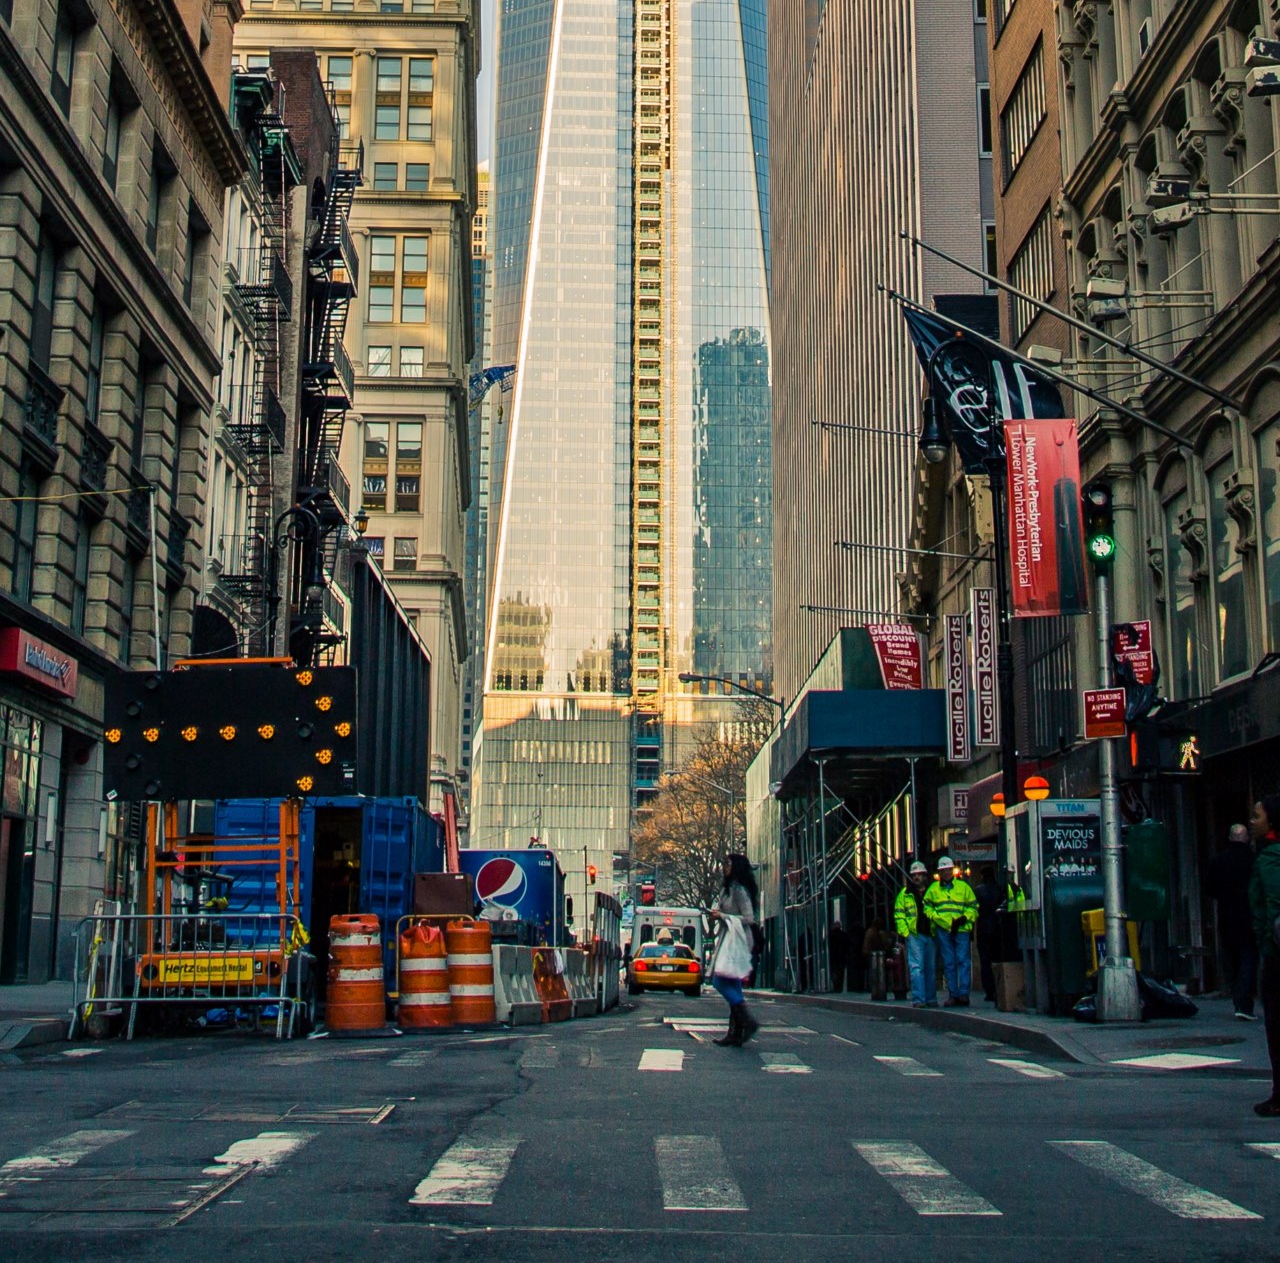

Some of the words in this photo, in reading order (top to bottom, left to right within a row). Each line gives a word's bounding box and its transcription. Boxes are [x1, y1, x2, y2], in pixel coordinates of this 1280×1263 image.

[1011, 437, 1022, 471] Lower
[1013, 474, 1026, 538] Manhattan
[1025, 438, 1043, 562] NewYork-Presbyterian
[1016, 539, 1032, 588] Hospital
[869, 625, 915, 636] GLOBAL
[976, 590, 992, 673] Roberts
[872, 635, 916, 643] DISCOUNT
[950, 616, 963, 693] Roberts
[884, 657, 919, 669] Incredibly
[1087, 695, 1095, 703] NO
[1096, 693, 1122, 701] STANDING
[980, 675, 993, 744] Lucille
[1091, 702, 1118, 712] ANYTIME
[952, 696, 965, 759] Lucille
[1056, 803, 1085, 812] TITAN
[1047, 829, 1095, 839] DEVIOUS
[1054, 839, 1089, 850] MAIDS
[164, 963, 195, 974] Hertz
